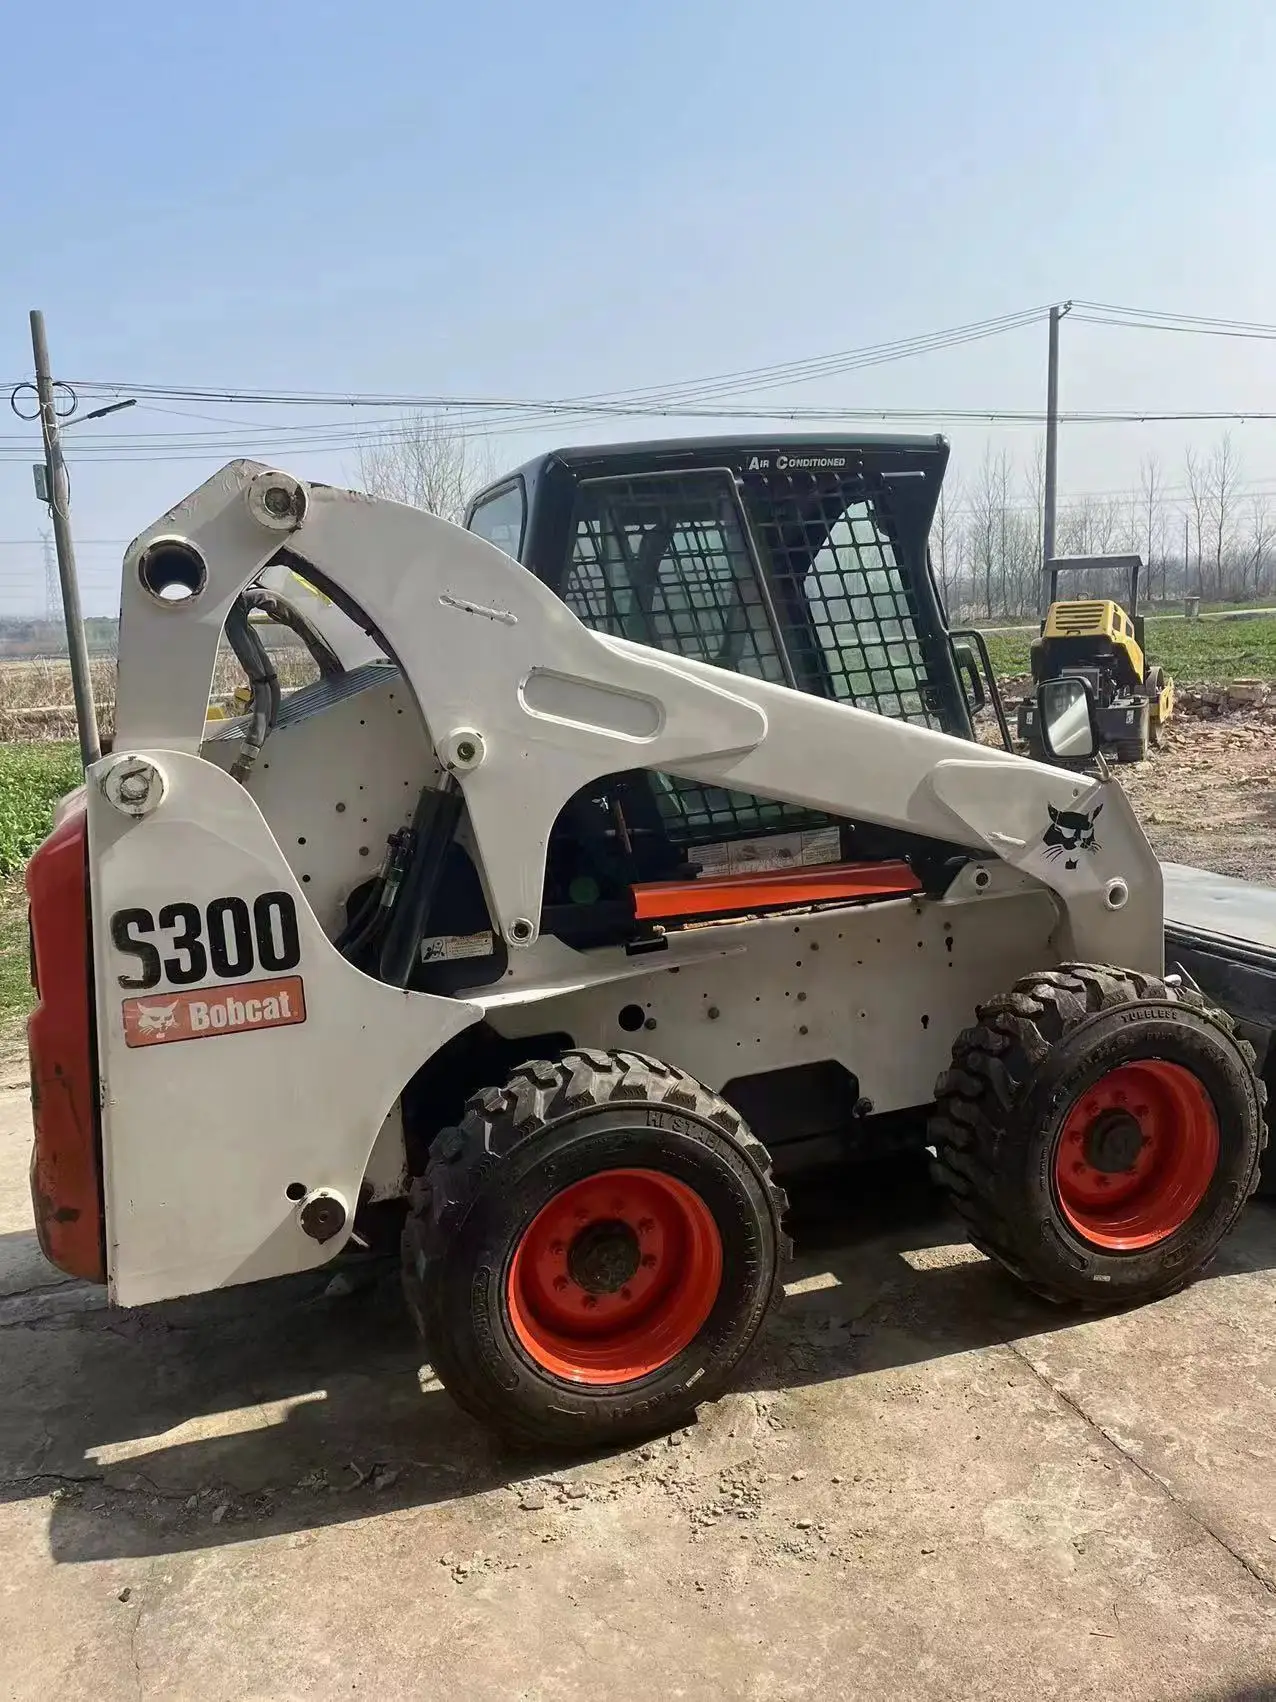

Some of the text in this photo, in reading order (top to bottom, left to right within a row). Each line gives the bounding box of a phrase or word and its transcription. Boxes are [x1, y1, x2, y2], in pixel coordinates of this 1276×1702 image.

[748, 456, 846, 470] AIR CONDITIONED
[110, 891, 301, 989] S300
[188, 991, 292, 1031] Bobcat
